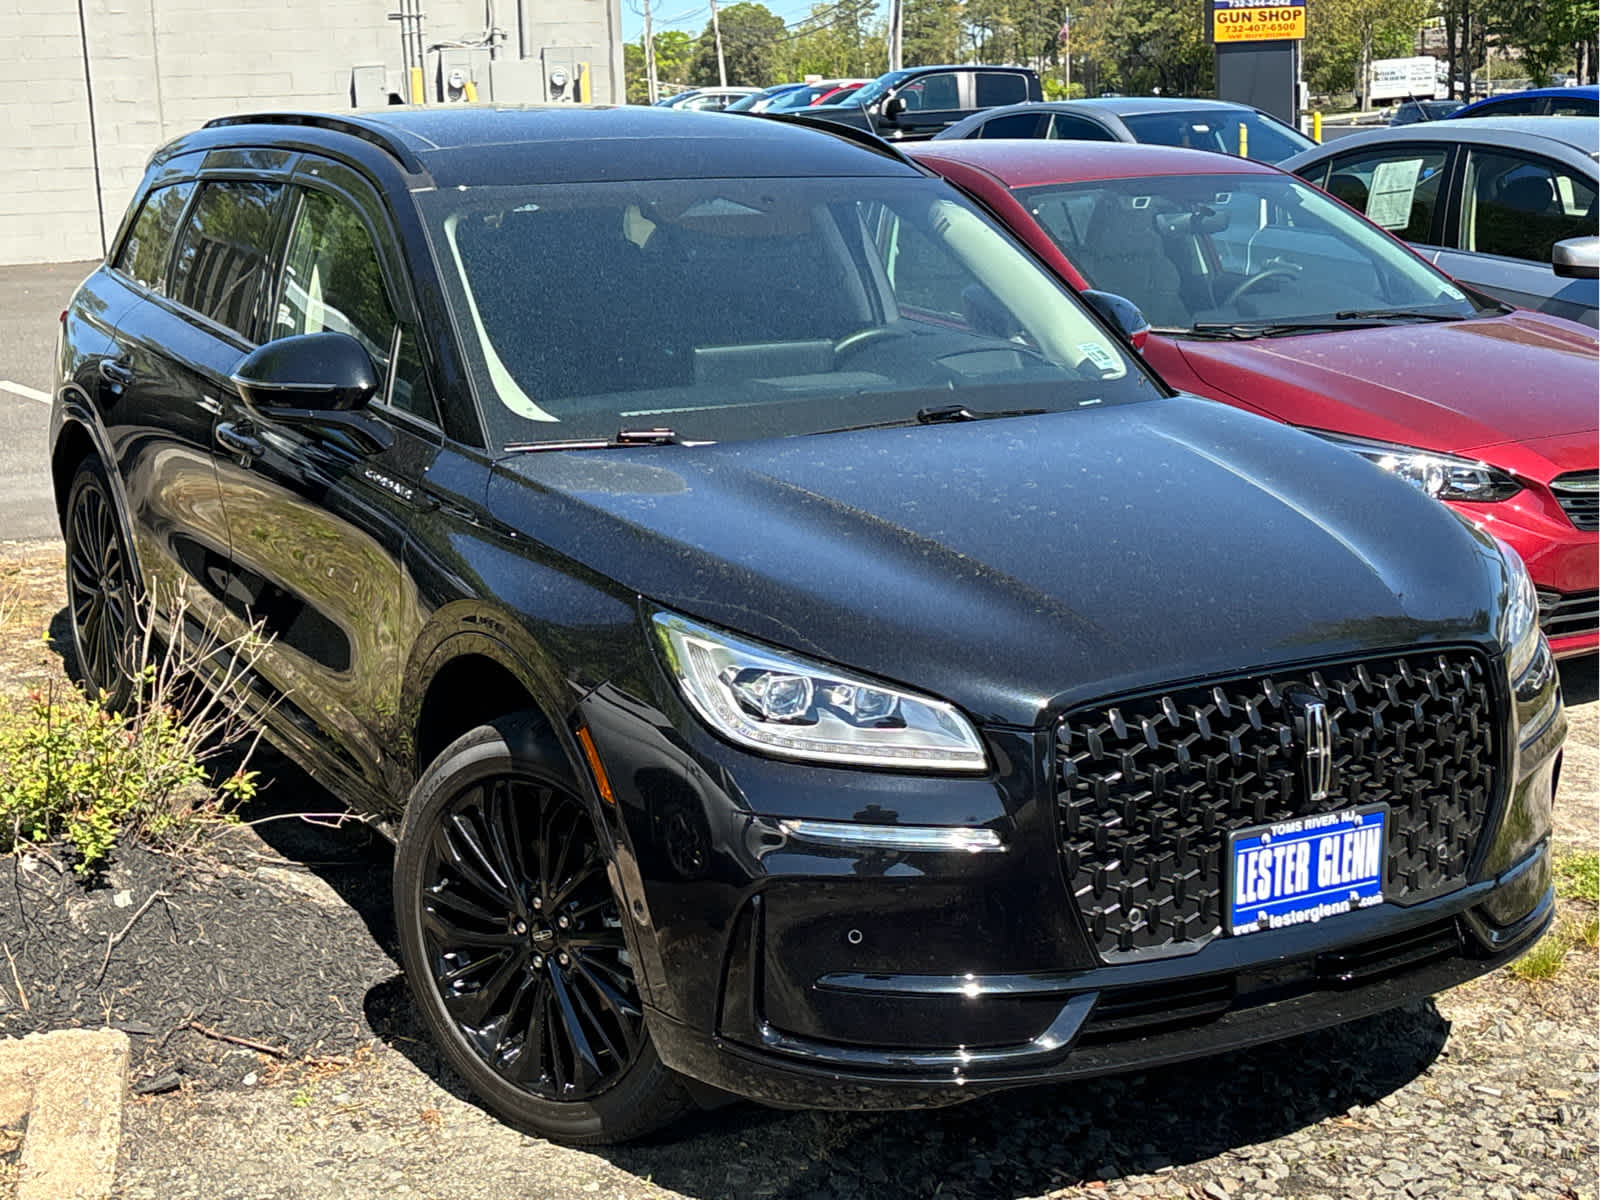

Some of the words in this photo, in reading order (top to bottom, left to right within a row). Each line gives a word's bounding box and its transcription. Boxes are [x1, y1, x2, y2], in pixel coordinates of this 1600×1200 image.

[1217, 11, 1252, 24] GUN
[1257, 9, 1302, 22] SHOP
[1225, 23, 1295, 33] 732-407-6500
[1270, 821, 1303, 836] TOMS
[1341, 810, 1355, 823] NJ
[1235, 841, 1310, 905] LESTER
[1317, 828, 1381, 888] GLENN
